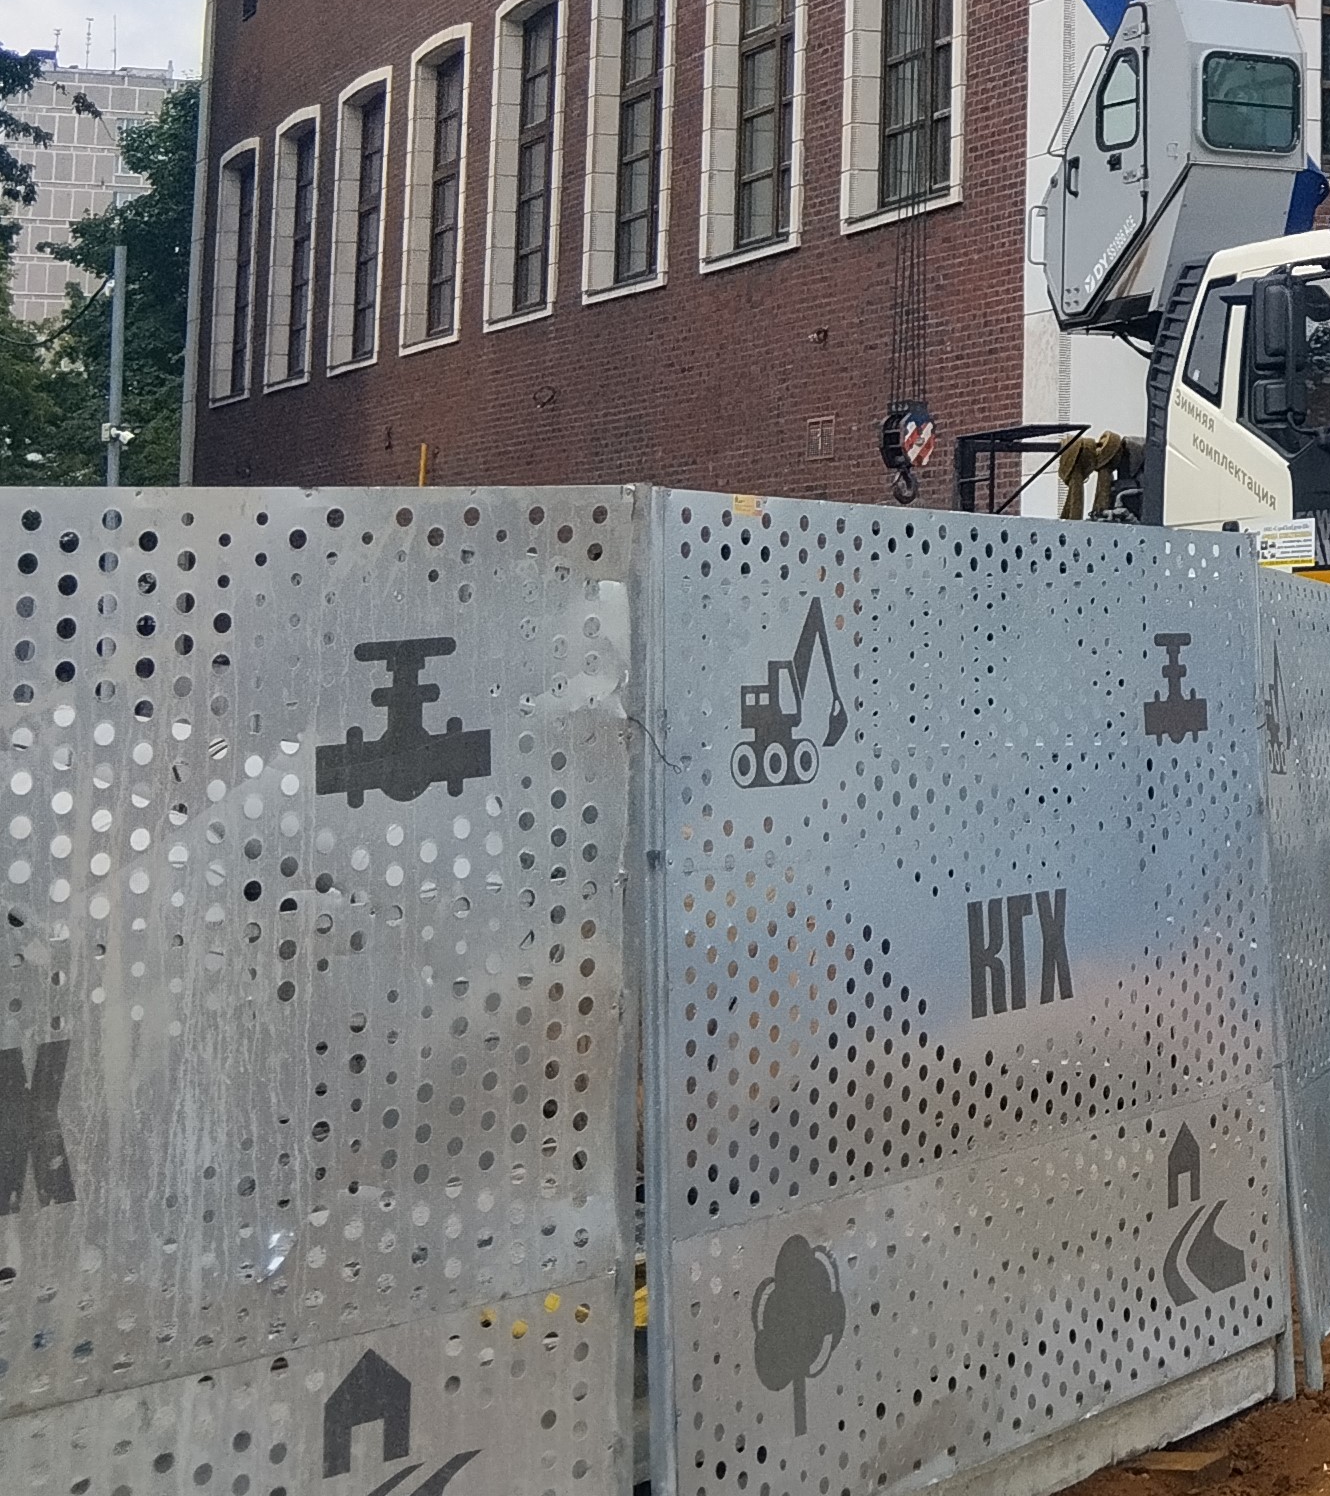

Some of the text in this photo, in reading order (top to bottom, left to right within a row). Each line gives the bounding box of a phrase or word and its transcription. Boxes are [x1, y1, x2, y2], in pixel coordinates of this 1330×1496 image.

[1174, 388, 1216, 434] Зимняя
[1192, 432, 1277, 511] комплектация
[966, 888, 1074, 1019] КГХ
